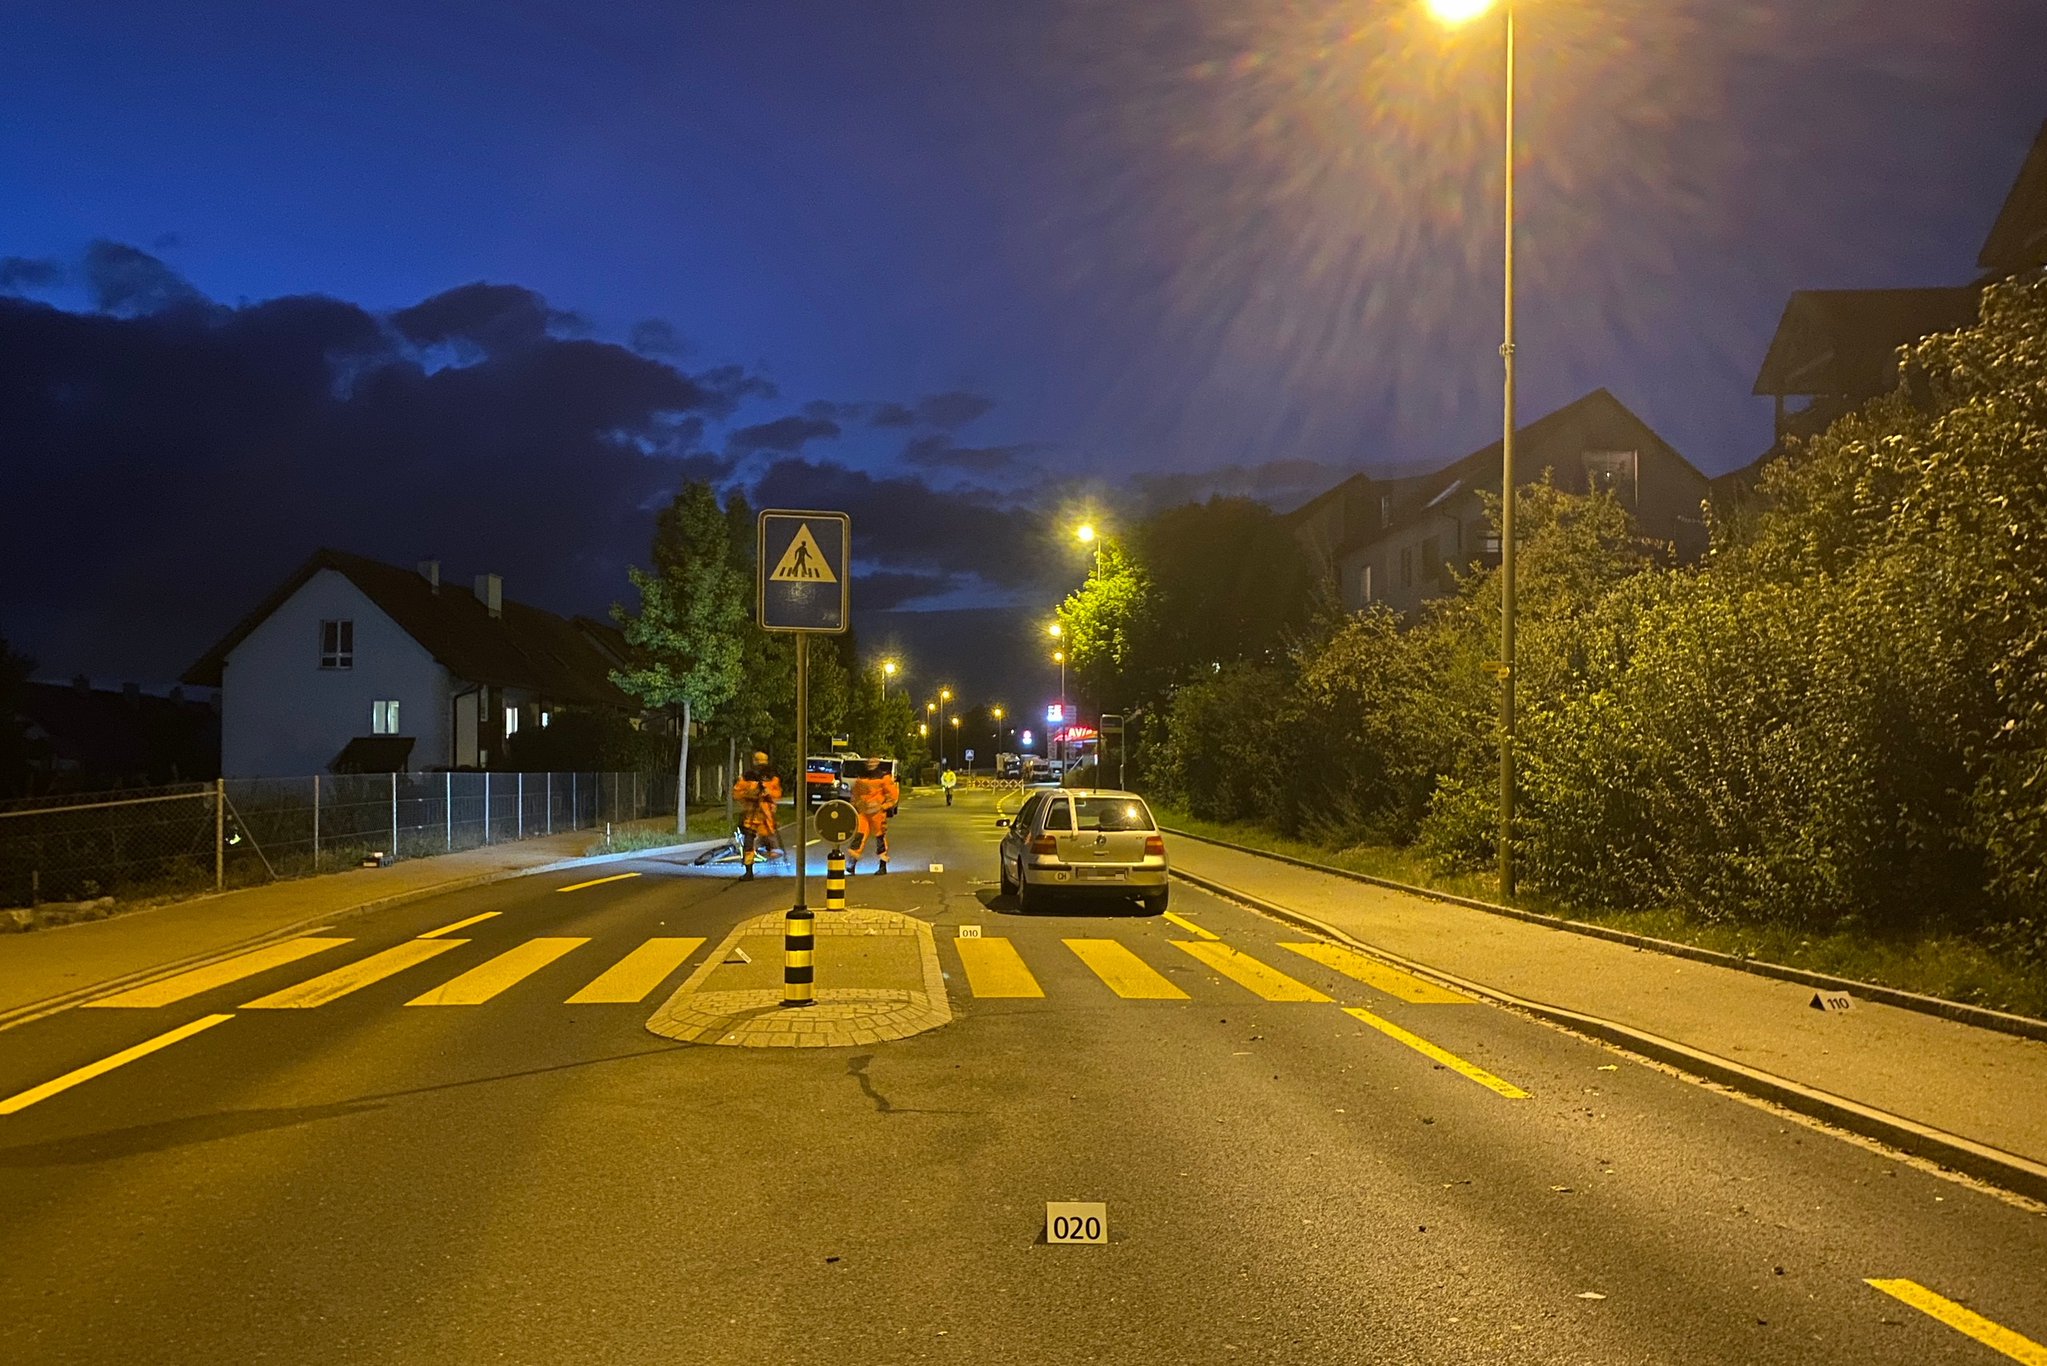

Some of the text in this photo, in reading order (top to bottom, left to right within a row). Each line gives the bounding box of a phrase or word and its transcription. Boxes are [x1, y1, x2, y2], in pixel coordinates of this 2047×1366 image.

[1057, 872, 1067, 880] CH
[962, 929, 978, 938] 010
[1827, 997, 1850, 1010] 110
[1053, 1216, 1101, 1240] 020
